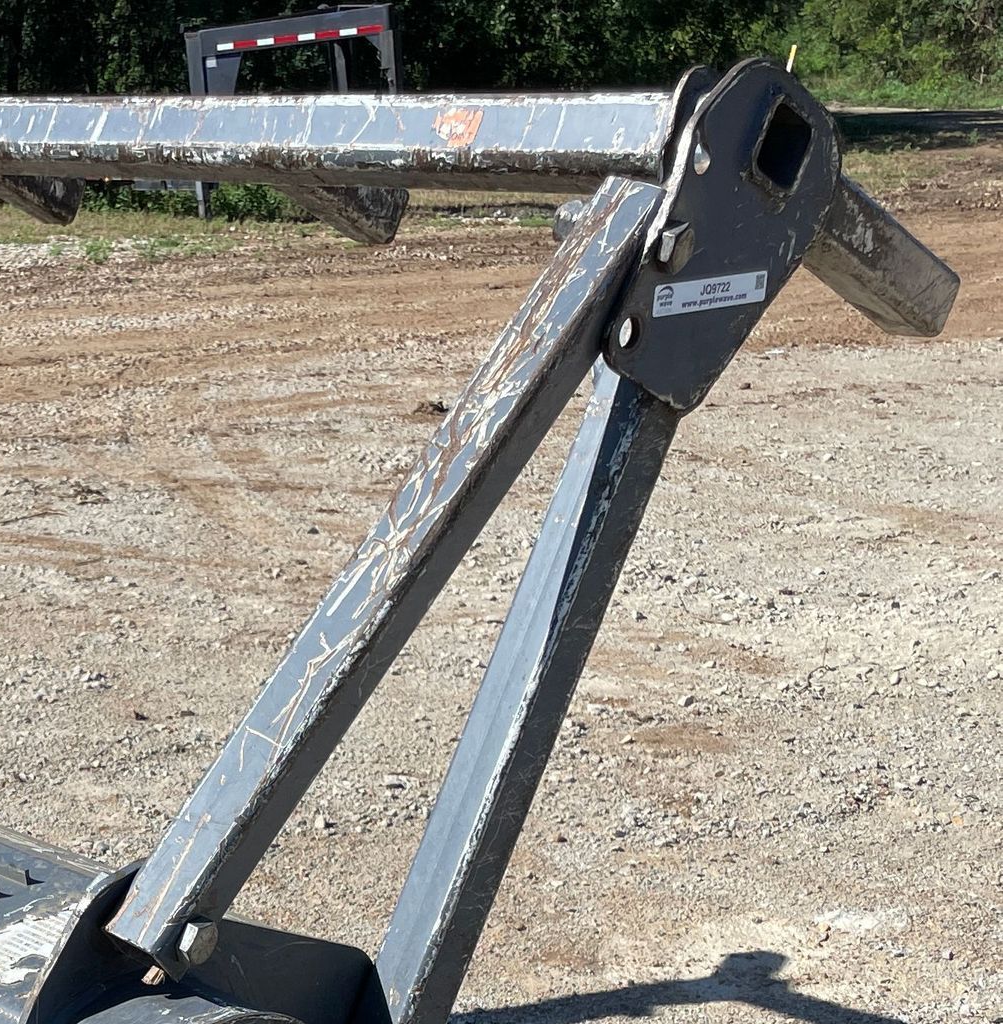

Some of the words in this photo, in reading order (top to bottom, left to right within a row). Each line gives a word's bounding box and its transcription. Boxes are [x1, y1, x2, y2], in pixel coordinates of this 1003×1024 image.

[700, 282, 731, 296] JQ9722
[656, 292, 673, 302] purple
[681, 293, 747, 309] www.purplewave.com
